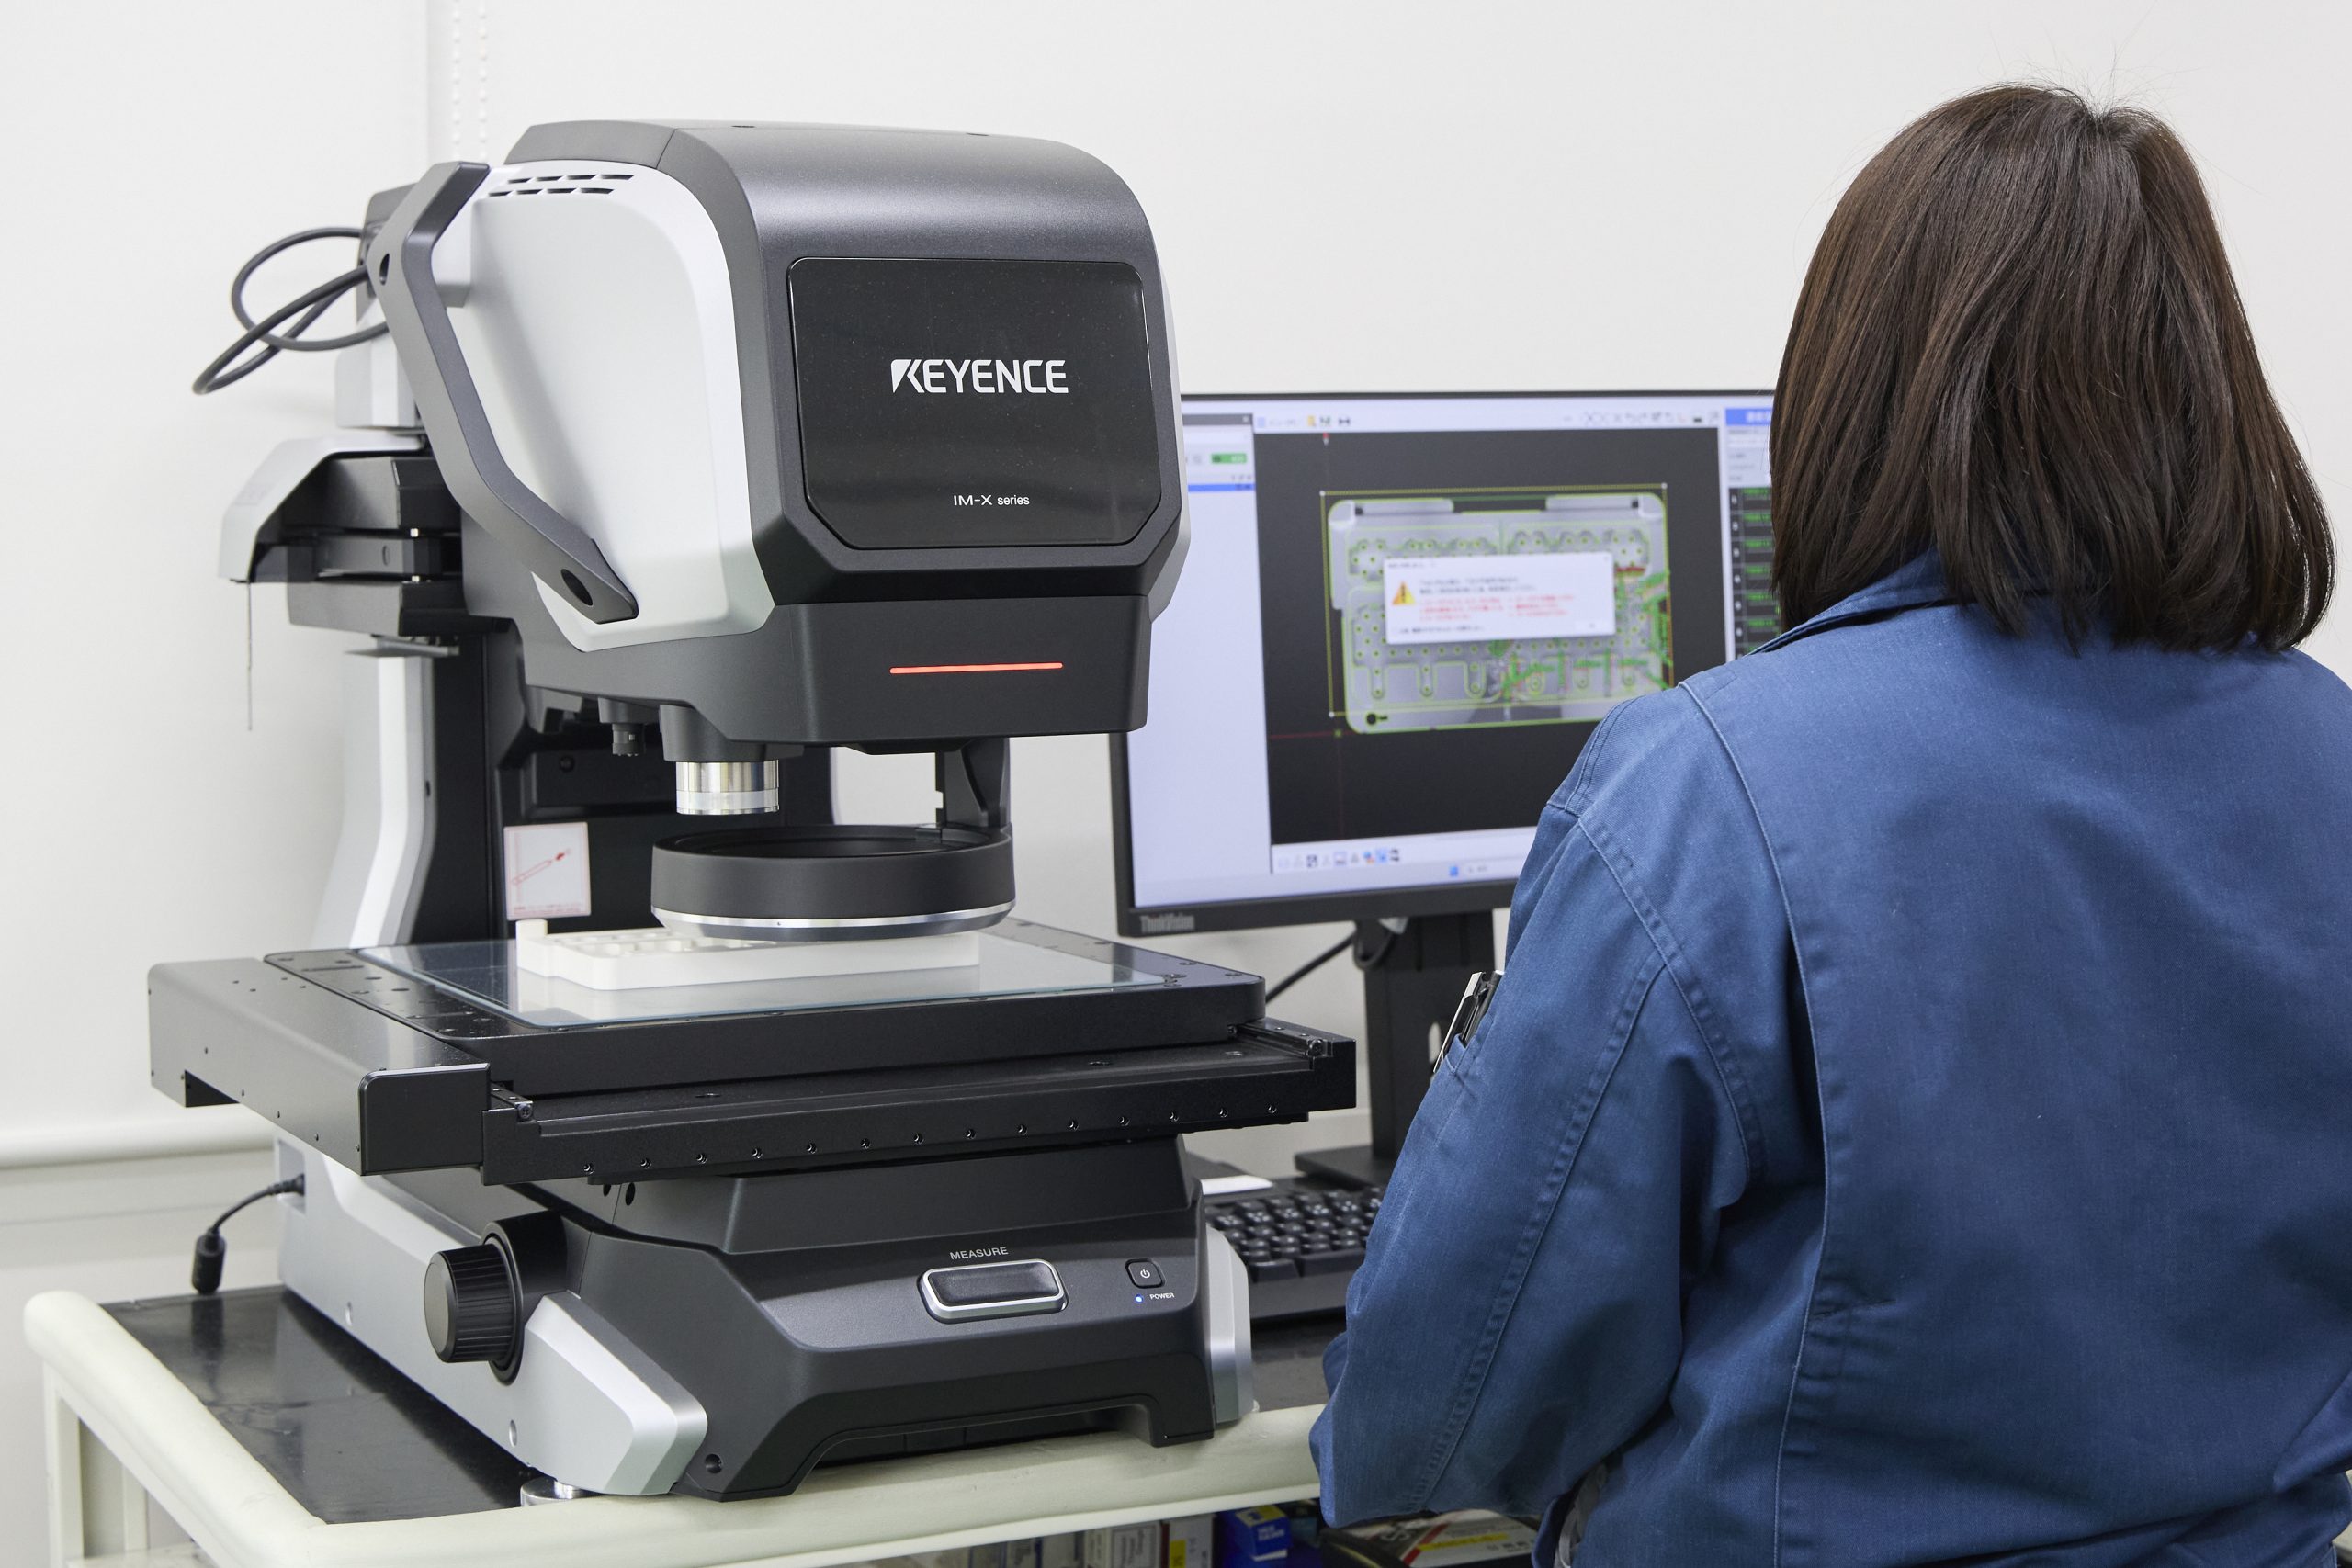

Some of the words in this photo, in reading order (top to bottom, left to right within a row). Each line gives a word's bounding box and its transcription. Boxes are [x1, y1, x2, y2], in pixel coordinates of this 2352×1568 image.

[890, 359, 1069, 394] KEYENCE
[953, 494, 993, 506] IM-X
[997, 494, 1030, 506] series
[950, 1247, 1009, 1260] MEASURE
[1149, 1292, 1175, 1301] POWER
